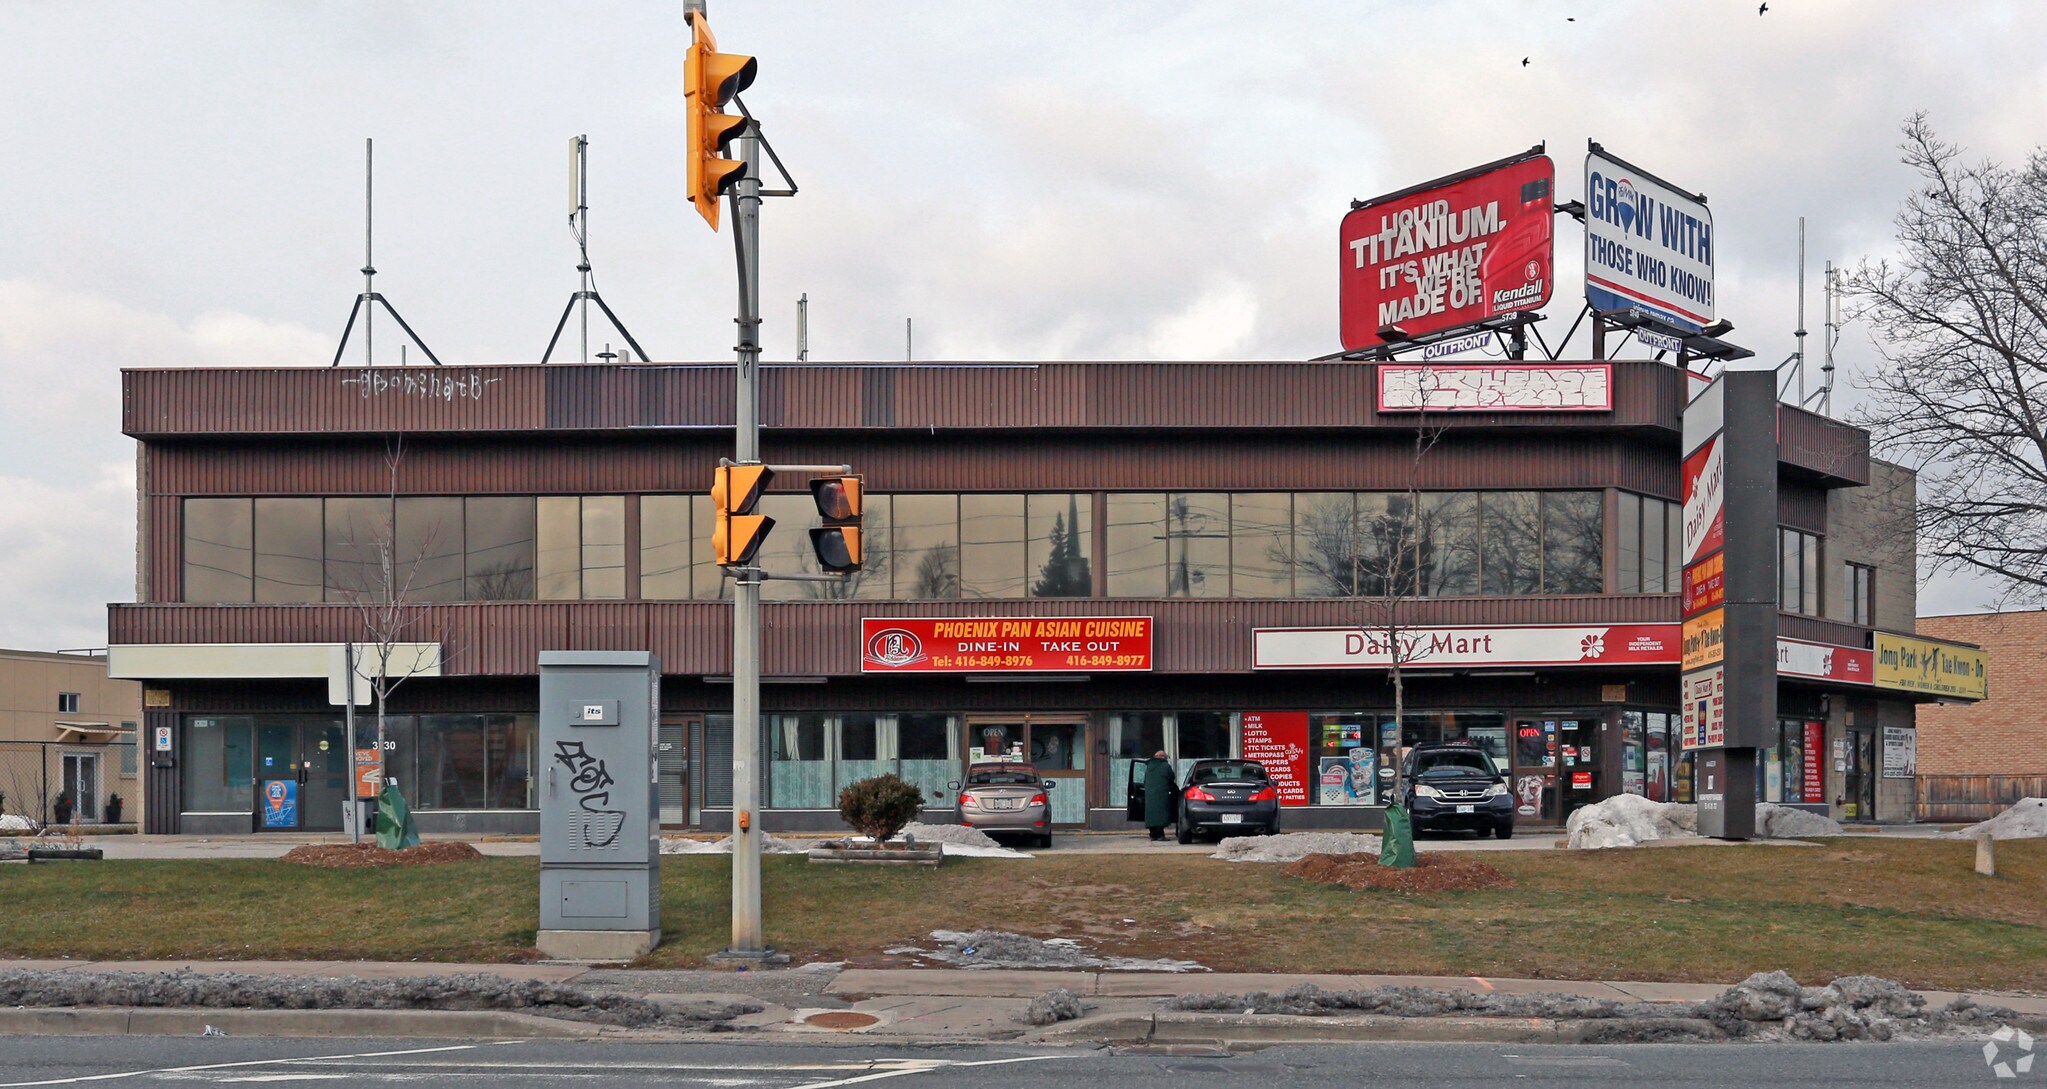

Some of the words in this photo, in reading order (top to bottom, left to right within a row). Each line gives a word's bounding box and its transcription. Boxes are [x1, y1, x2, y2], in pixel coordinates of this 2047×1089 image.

[1382, 200, 1448, 236] LIQUID
[1659, 202, 1711, 267] WITH
[1380, 260, 1418, 290] IT'S
[1422, 242, 1487, 277] WHAT
[1590, 232, 1633, 276] THOSE
[1636, 251, 1666, 288] WHO
[1670, 265, 1711, 307] KNOW!
[1416, 264, 1481, 296] WE'RE
[1493, 279, 1543, 304] Kendall
[1378, 286, 1446, 327] MADE
[1450, 284, 1482, 310] OF.
[1493, 302, 1514, 312] LIQUID
[1514, 294, 1542, 307] TITANIUM
[1501, 312, 1518, 322] 5739
[1425, 333, 1488, 358] OUTFRONT
[1639, 329, 1680, 351] OUTFRONT
[934, 622, 998, 638] PHOENIX
[1001, 622, 1032, 638] PAN
[1034, 621, 1080, 638] ASIAN
[1084, 621, 1144, 638] CUISINE
[958, 642, 1020, 652] DINE-IN
[1040, 641, 1081, 652] TAKE
[1087, 641, 1120, 652] OUT
[1432, 632, 1492, 654] Mart
[932, 656, 952, 667] Tel:
[955, 655, 1032, 666] 416-849-8976
[1066, 654, 1144, 666] 416-849-8977
[1777, 646, 1789, 664] art
[1879, 644, 1898, 672] Jong
[1901, 646, 1918, 669] Park
[1942, 653, 1952, 674] Tae
[1954, 655, 1970, 676] Kwon
[1976, 658, 1984, 678] Do
[983, 728, 1004, 736] OPEN
[1520, 728, 1540, 737] OPEN
[372, 741, 396, 750] 330
